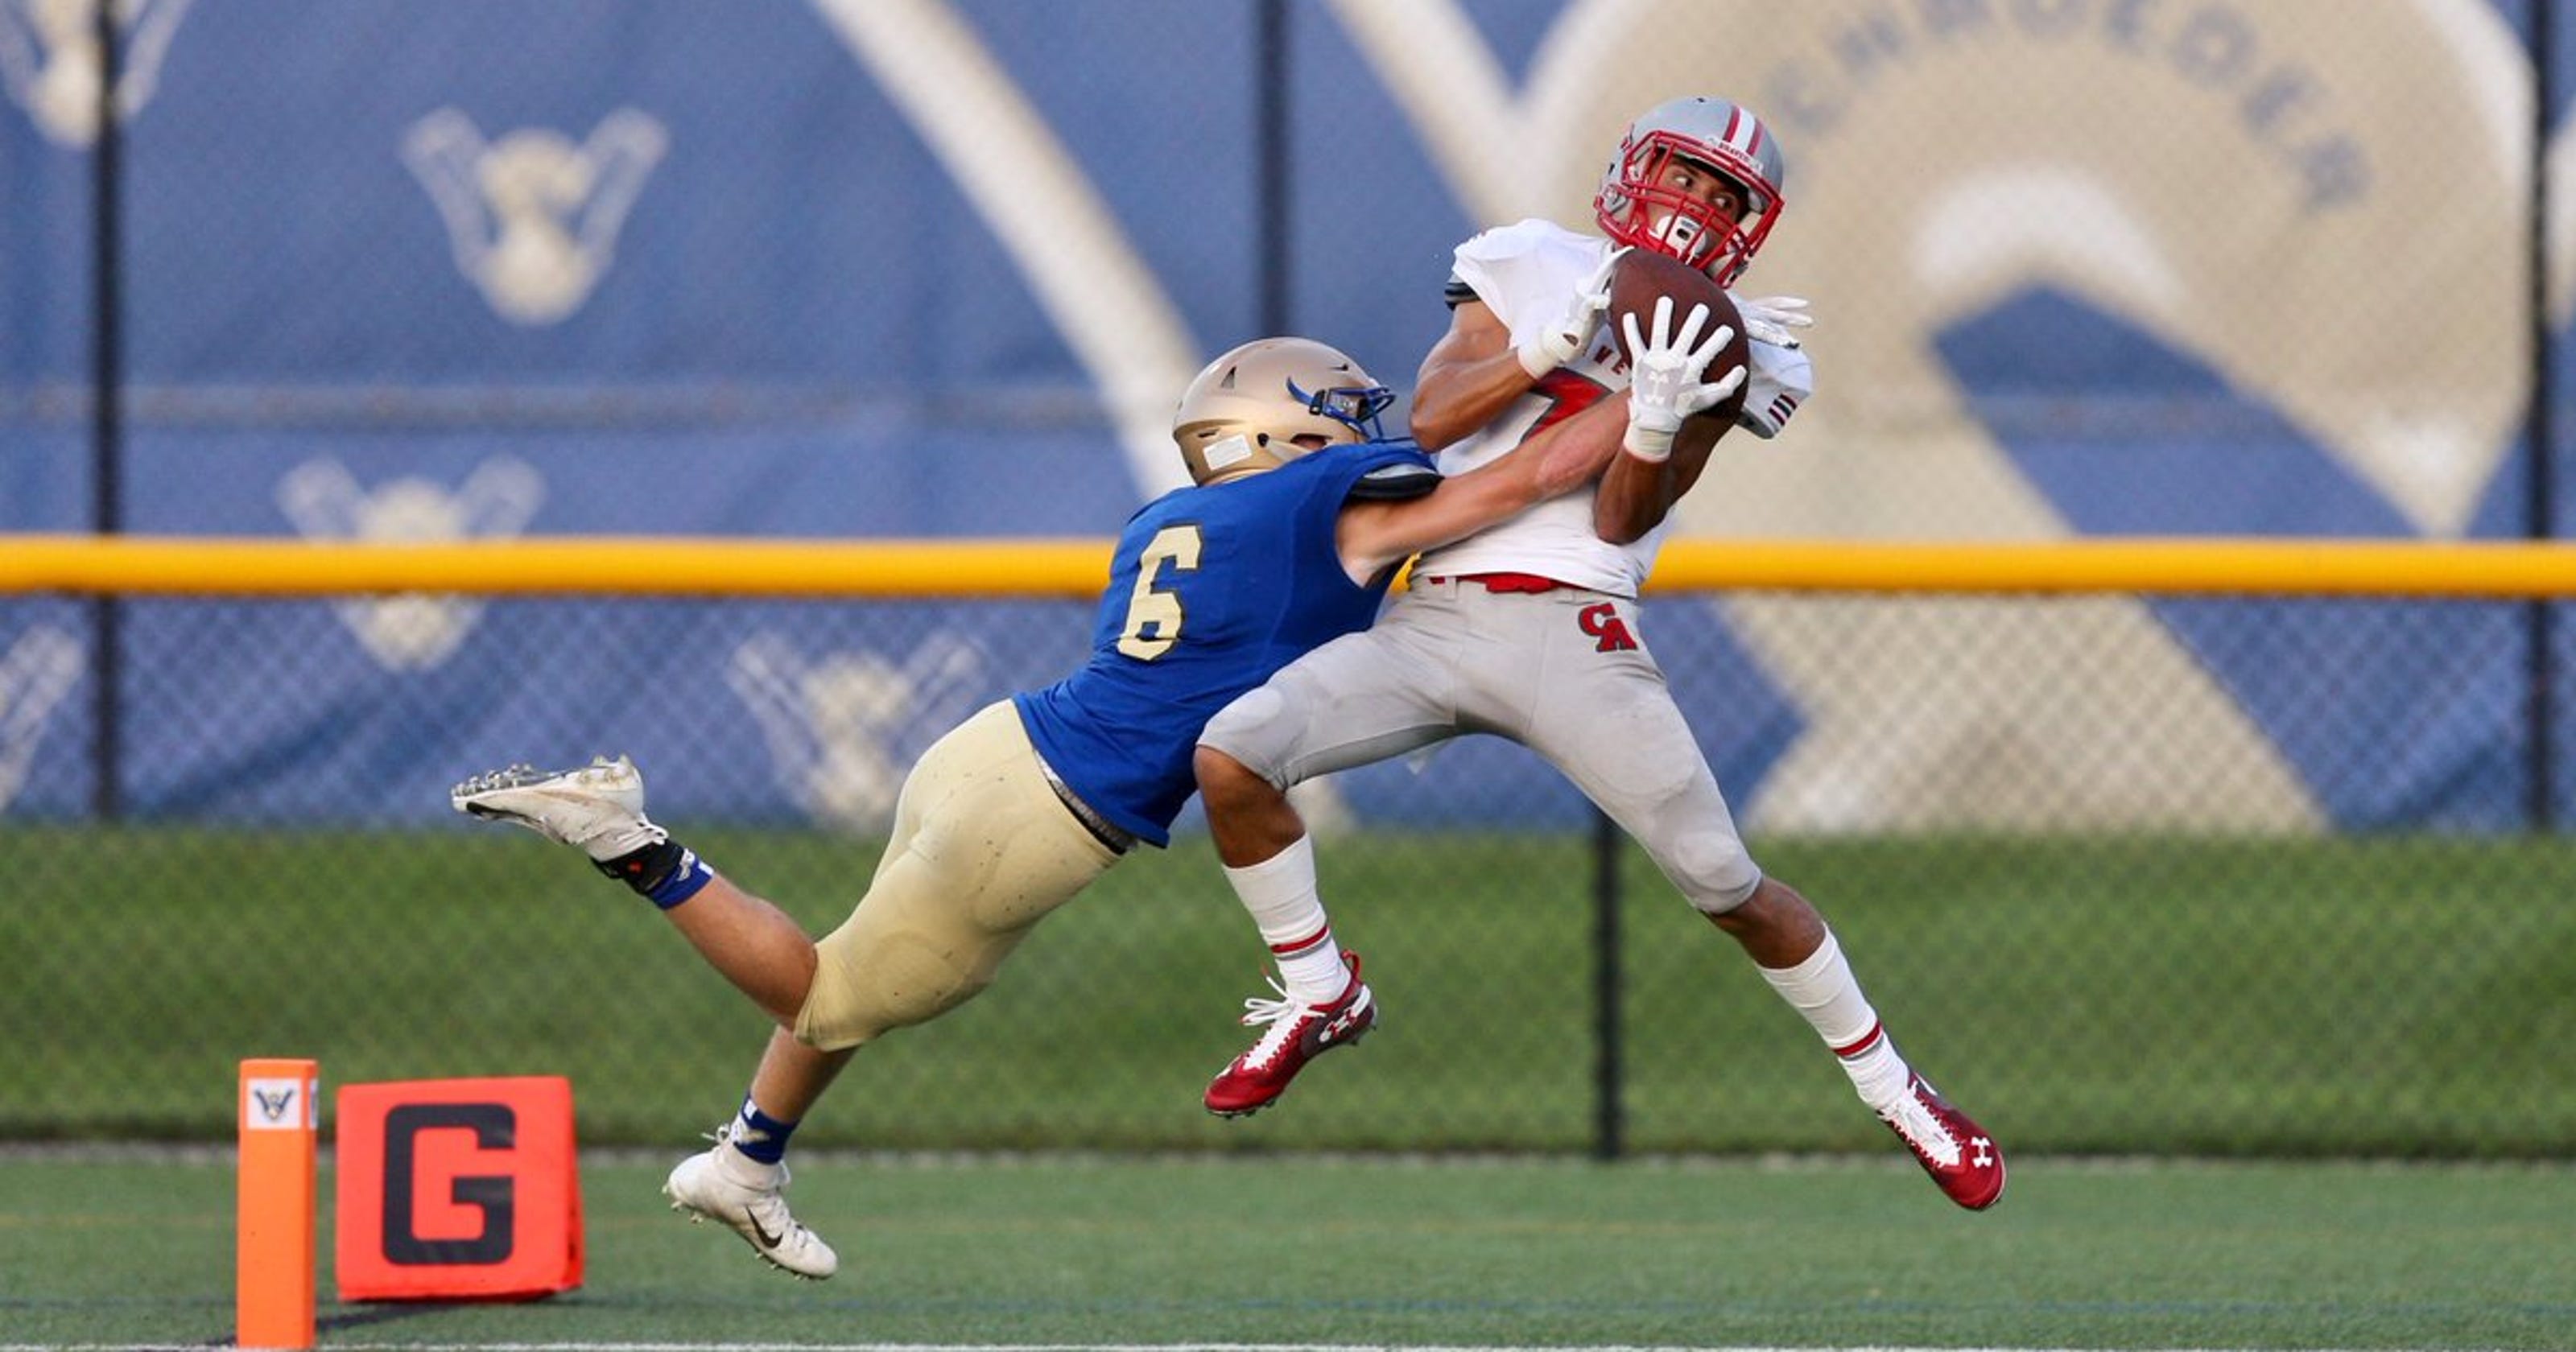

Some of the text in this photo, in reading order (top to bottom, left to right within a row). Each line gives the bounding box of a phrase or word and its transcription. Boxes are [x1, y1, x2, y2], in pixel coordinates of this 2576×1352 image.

[1117, 525, 1201, 661] 6
[1579, 602, 1638, 653] CA
[382, 1103, 516, 1265] G
